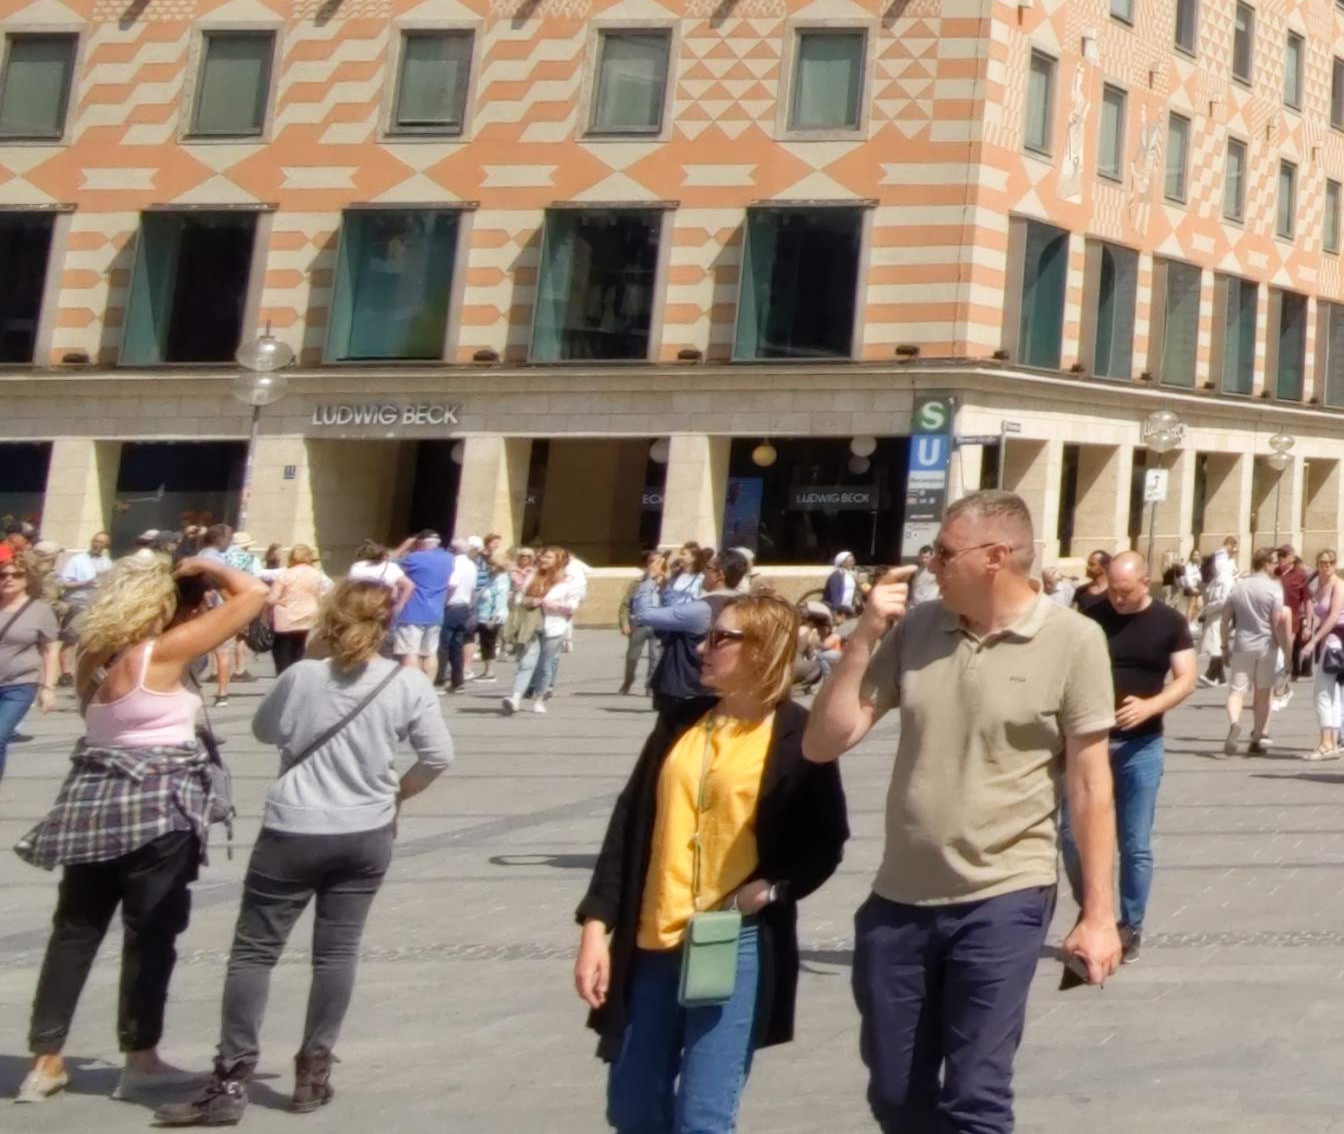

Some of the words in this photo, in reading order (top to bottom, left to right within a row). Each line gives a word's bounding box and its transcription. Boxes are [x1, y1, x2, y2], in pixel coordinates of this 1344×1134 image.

[312, 405, 399, 426] LUDWIG
[401, 404, 459, 425] BECK
[920, 401, 945, 430] S
[917, 438, 941, 466] U
[796, 493, 840, 504] LUDWIG
[840, 492, 870, 504] BECK
